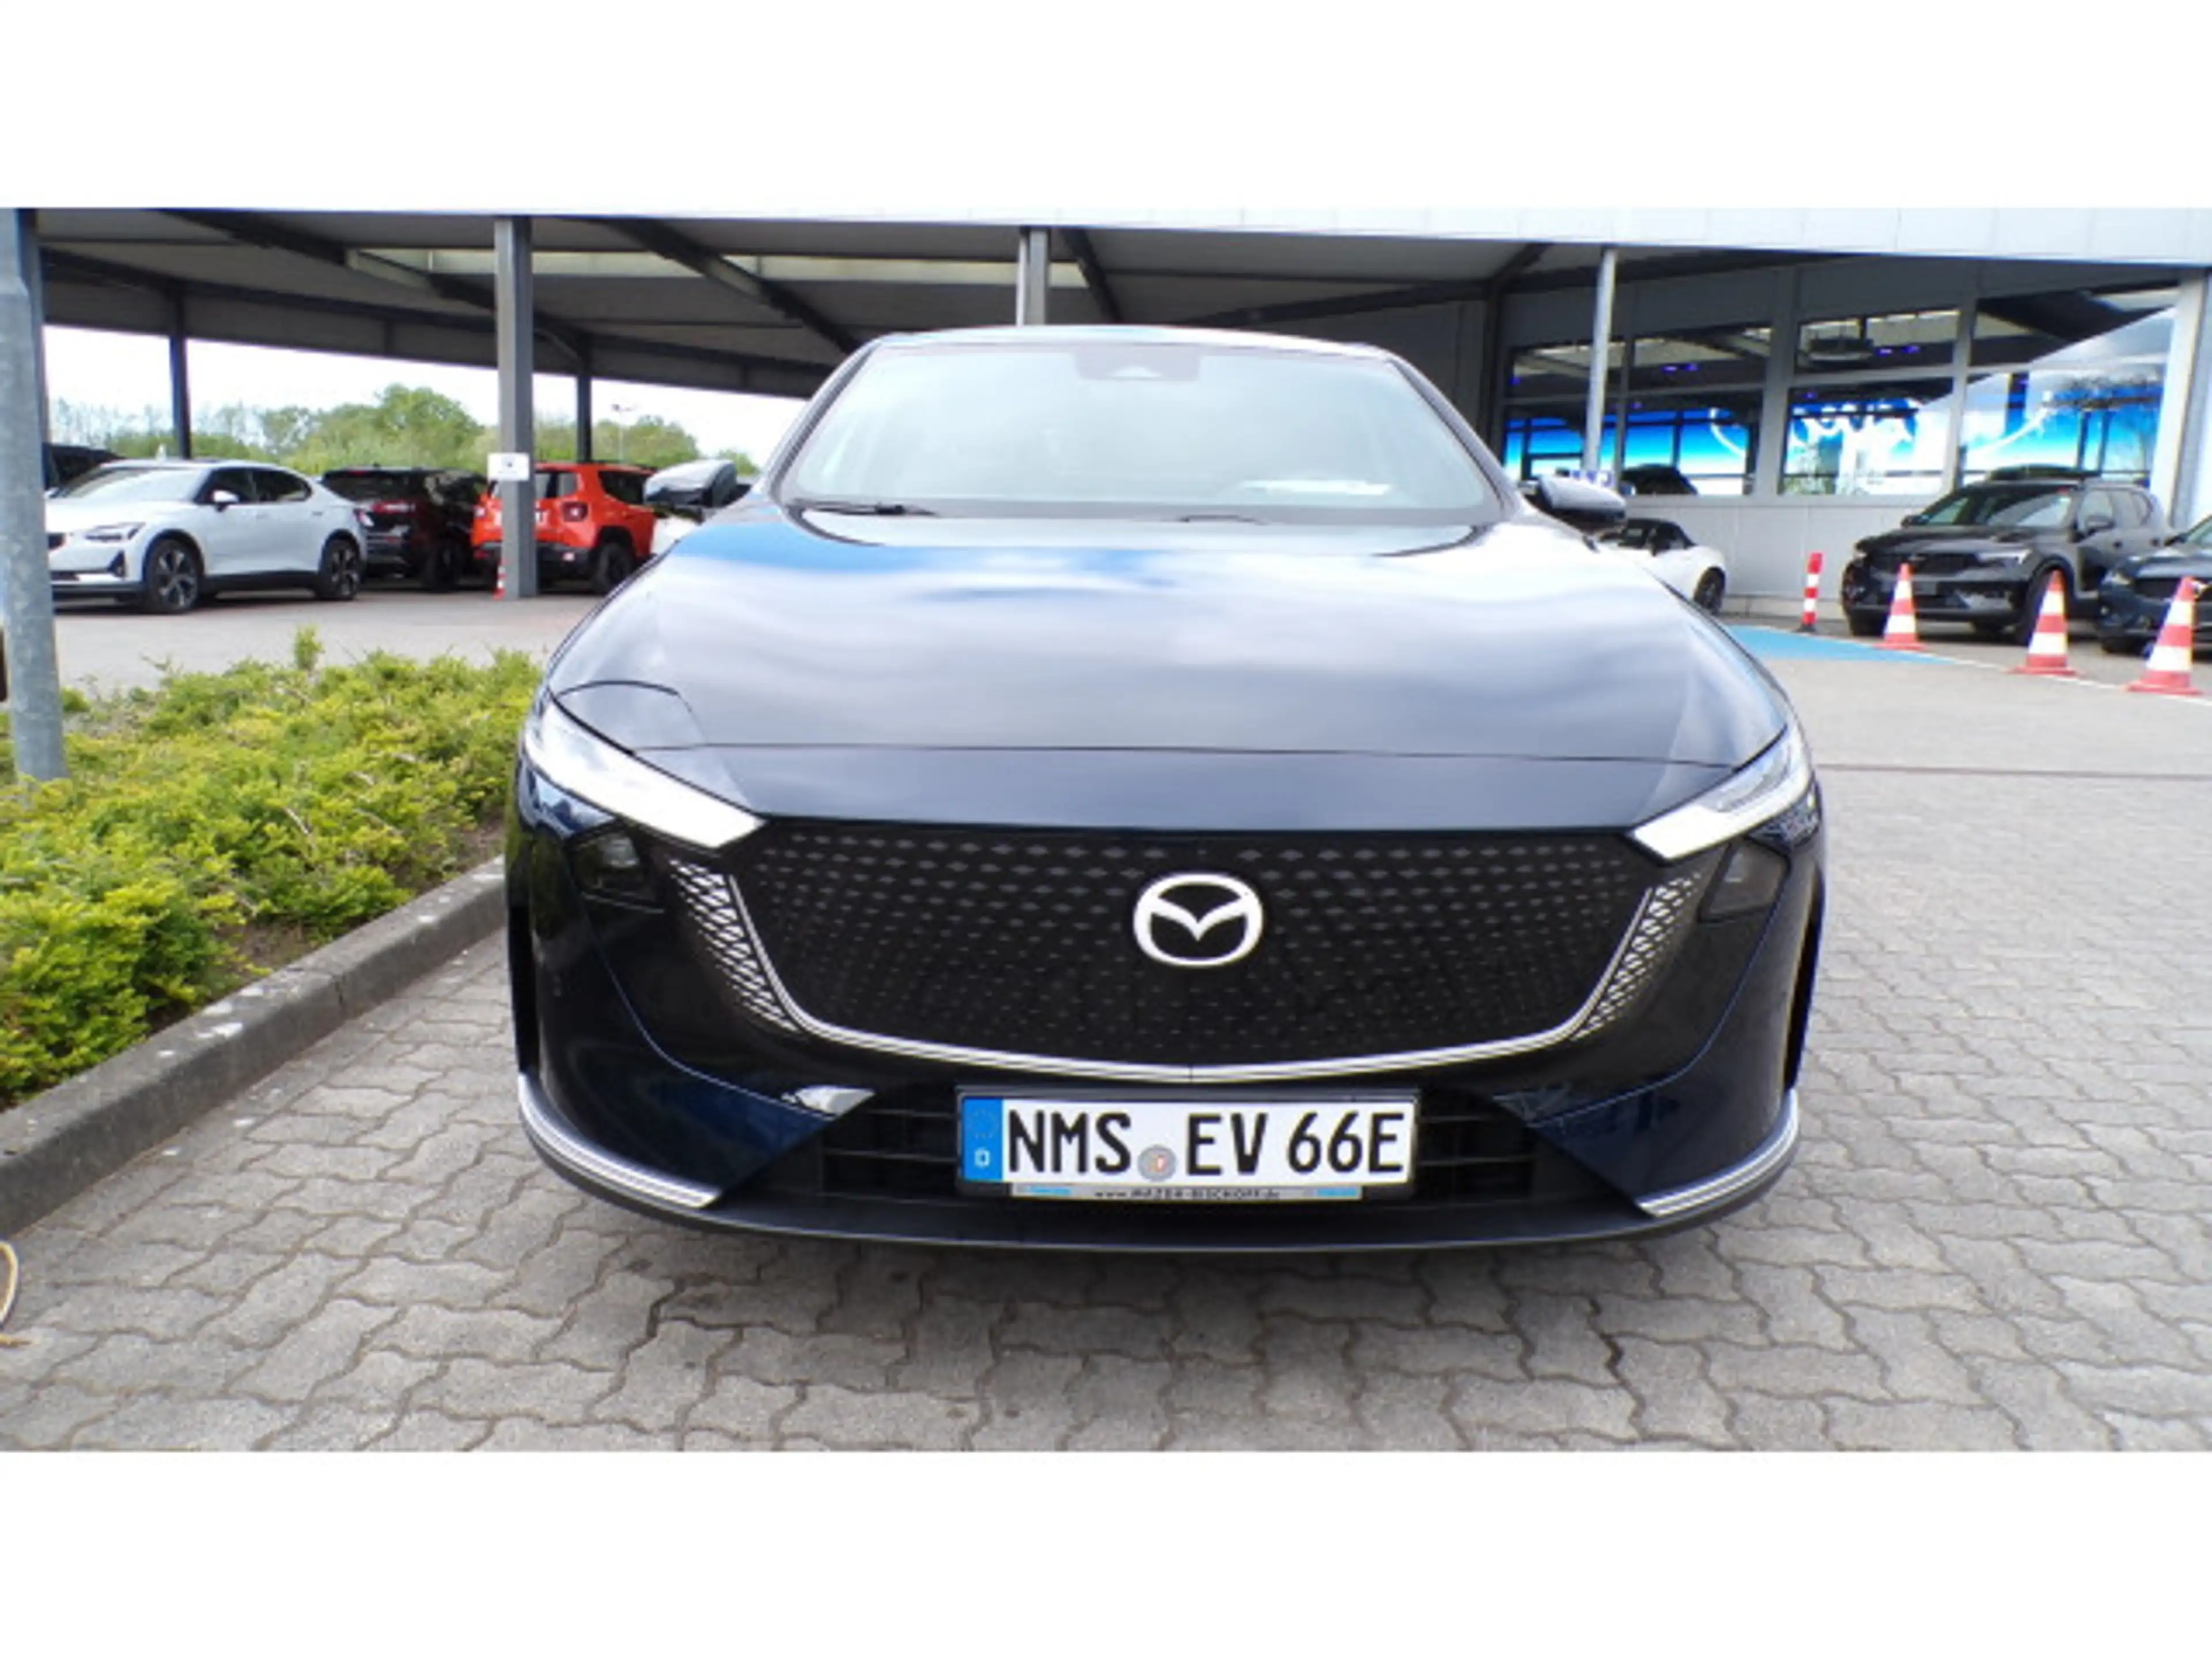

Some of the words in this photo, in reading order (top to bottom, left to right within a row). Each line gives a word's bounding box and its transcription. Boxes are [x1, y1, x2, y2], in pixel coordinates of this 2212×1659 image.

[1009, 1110, 1131, 1174] NMS
[1187, 1113, 1267, 1176] EV
[1287, 1112, 1404, 1174] 66E
